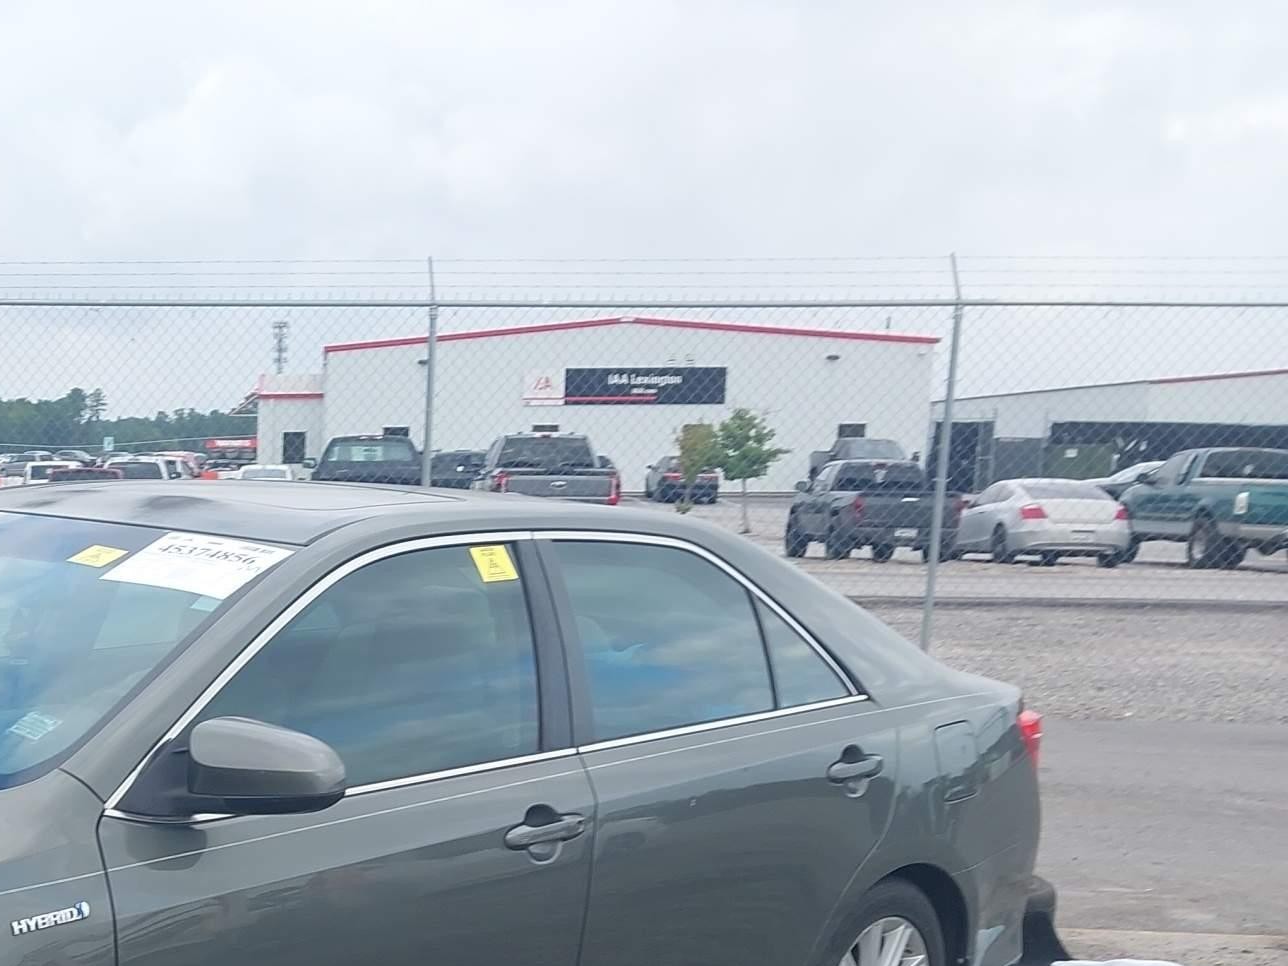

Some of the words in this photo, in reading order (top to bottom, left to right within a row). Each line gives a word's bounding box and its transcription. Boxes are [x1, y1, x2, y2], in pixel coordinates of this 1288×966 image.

[630, 373, 682, 387] Lexington
[158, 543, 258, 565] 45374856
[11, 906, 79, 935] HYBRID
